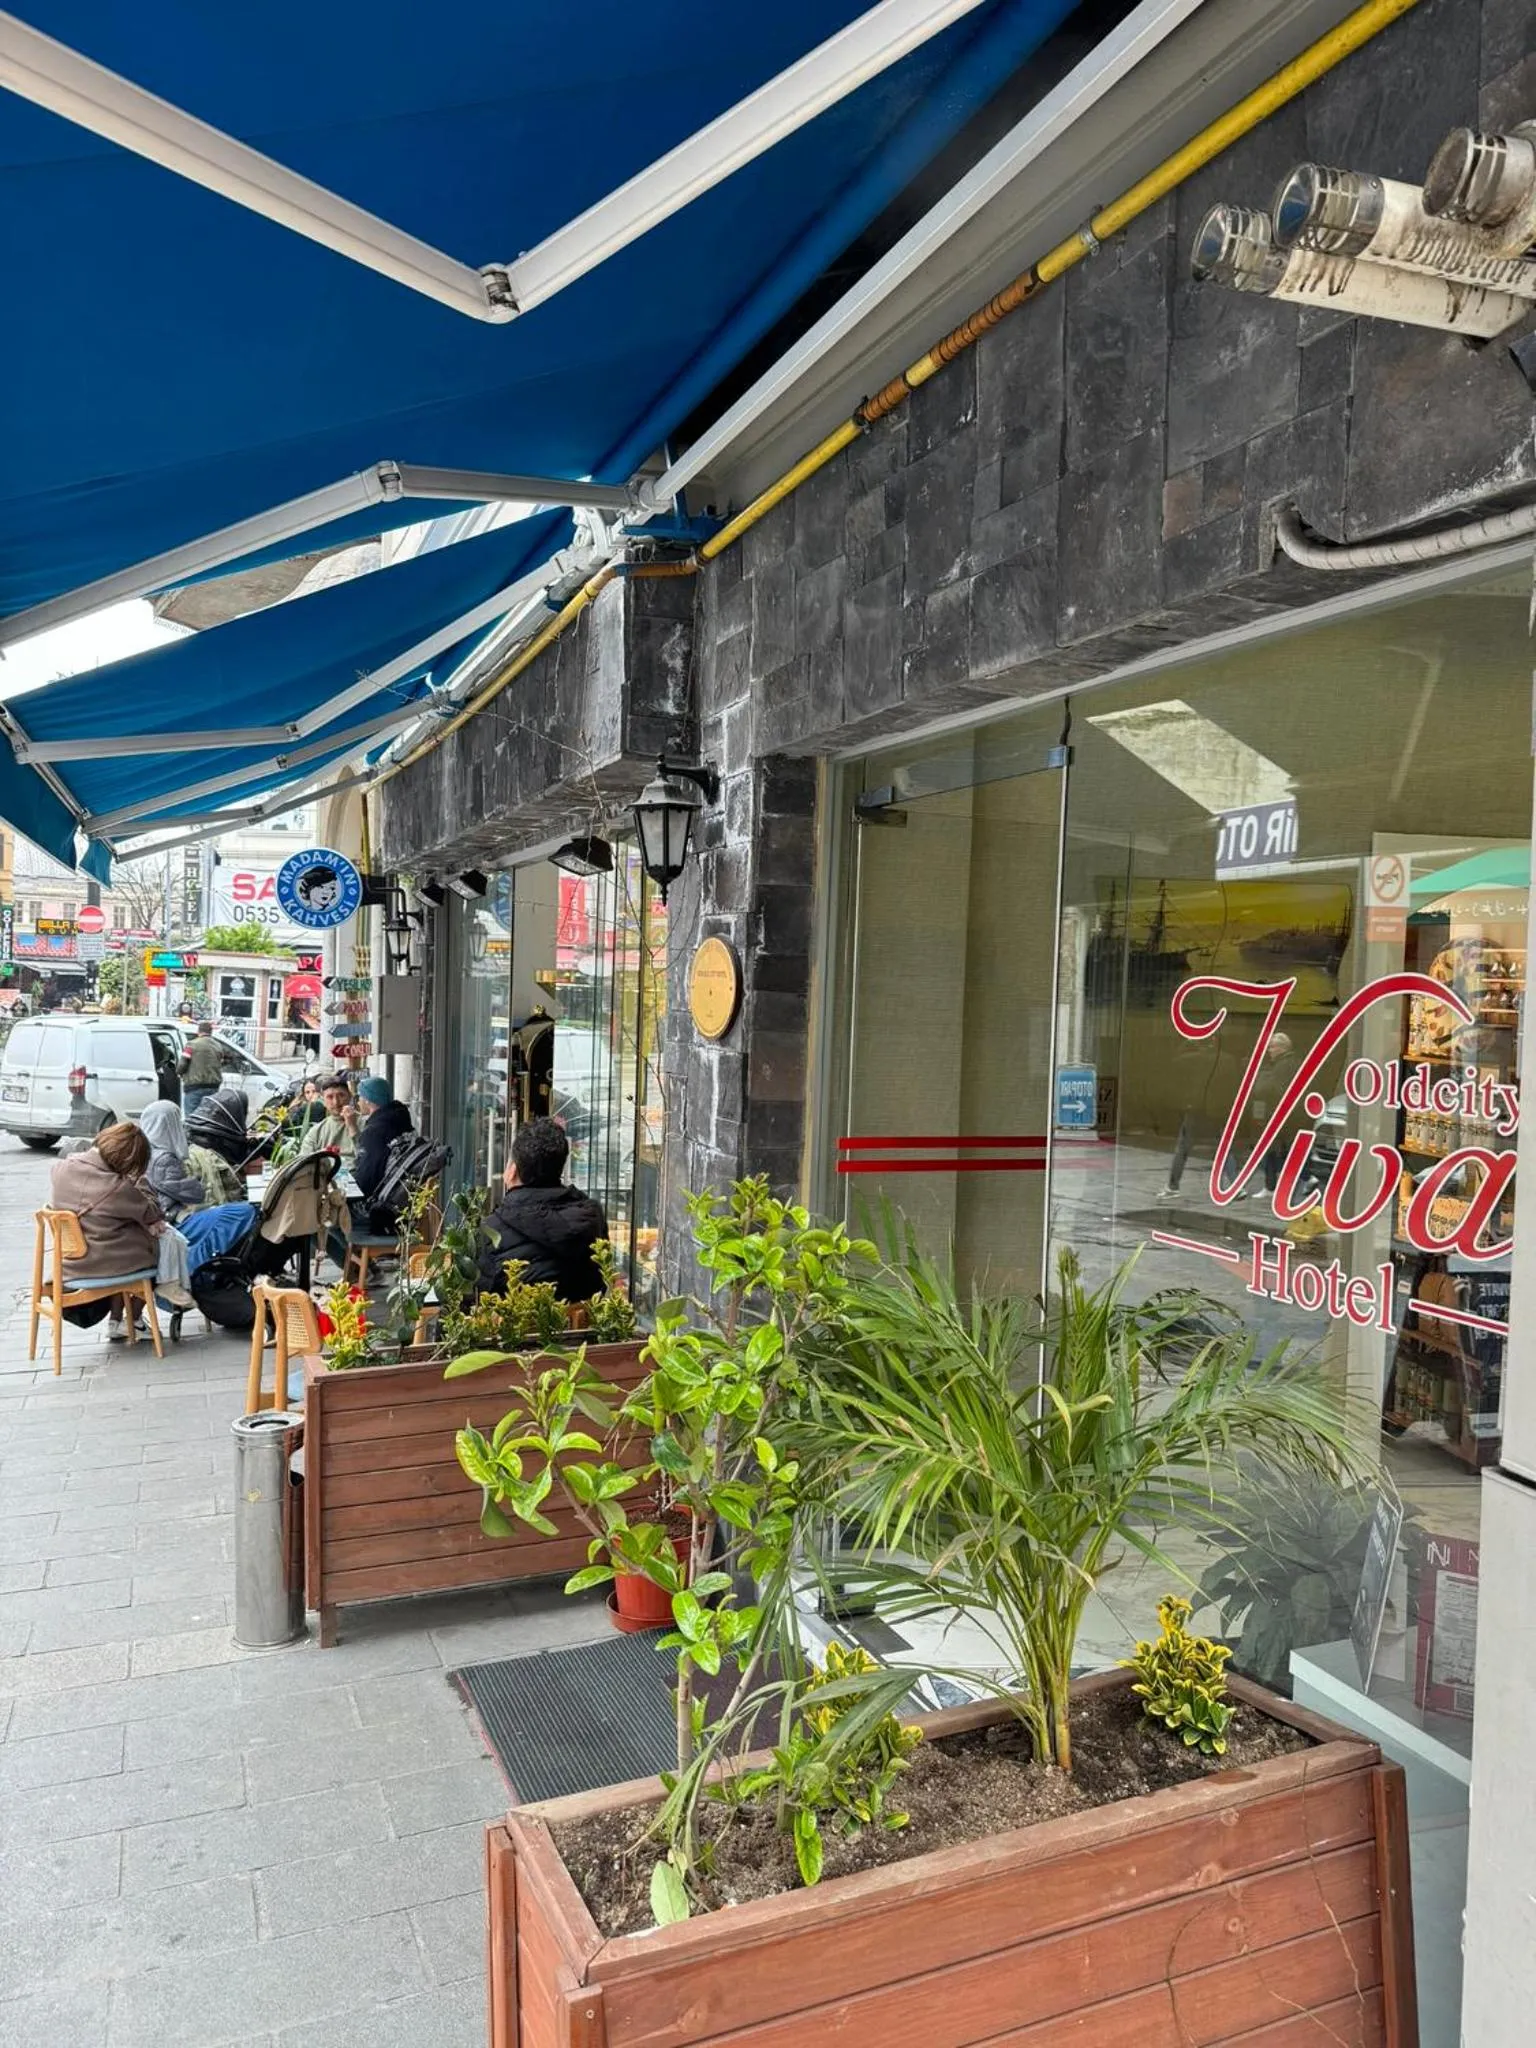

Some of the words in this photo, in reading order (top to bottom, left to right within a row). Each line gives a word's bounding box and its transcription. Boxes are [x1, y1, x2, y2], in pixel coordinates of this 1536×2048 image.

[233, 905, 280, 924] 0535
[1170, 972, 1518, 1262] Viva
[1344, 1057, 1520, 1136] Oldcity
[1247, 1231, 1397, 1334] Hotel
